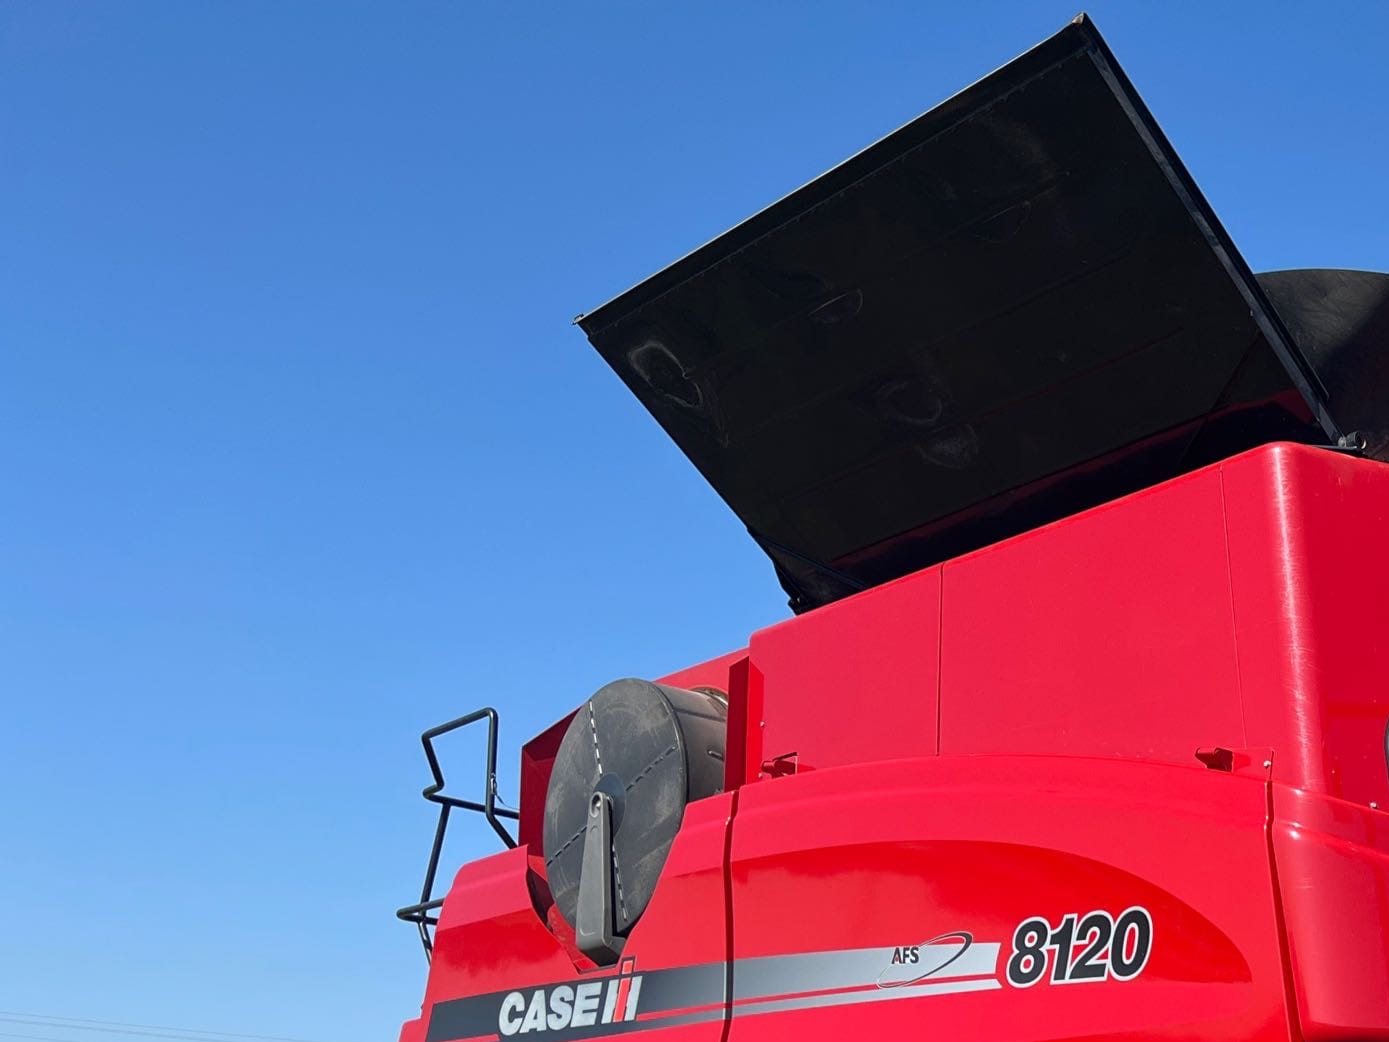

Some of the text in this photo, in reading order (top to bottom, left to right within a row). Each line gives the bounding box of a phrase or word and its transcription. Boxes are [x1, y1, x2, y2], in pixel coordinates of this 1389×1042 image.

[891, 946, 920, 965] AFS
[1006, 906, 1153, 989] 8120
[499, 982, 602, 1036] CASE
